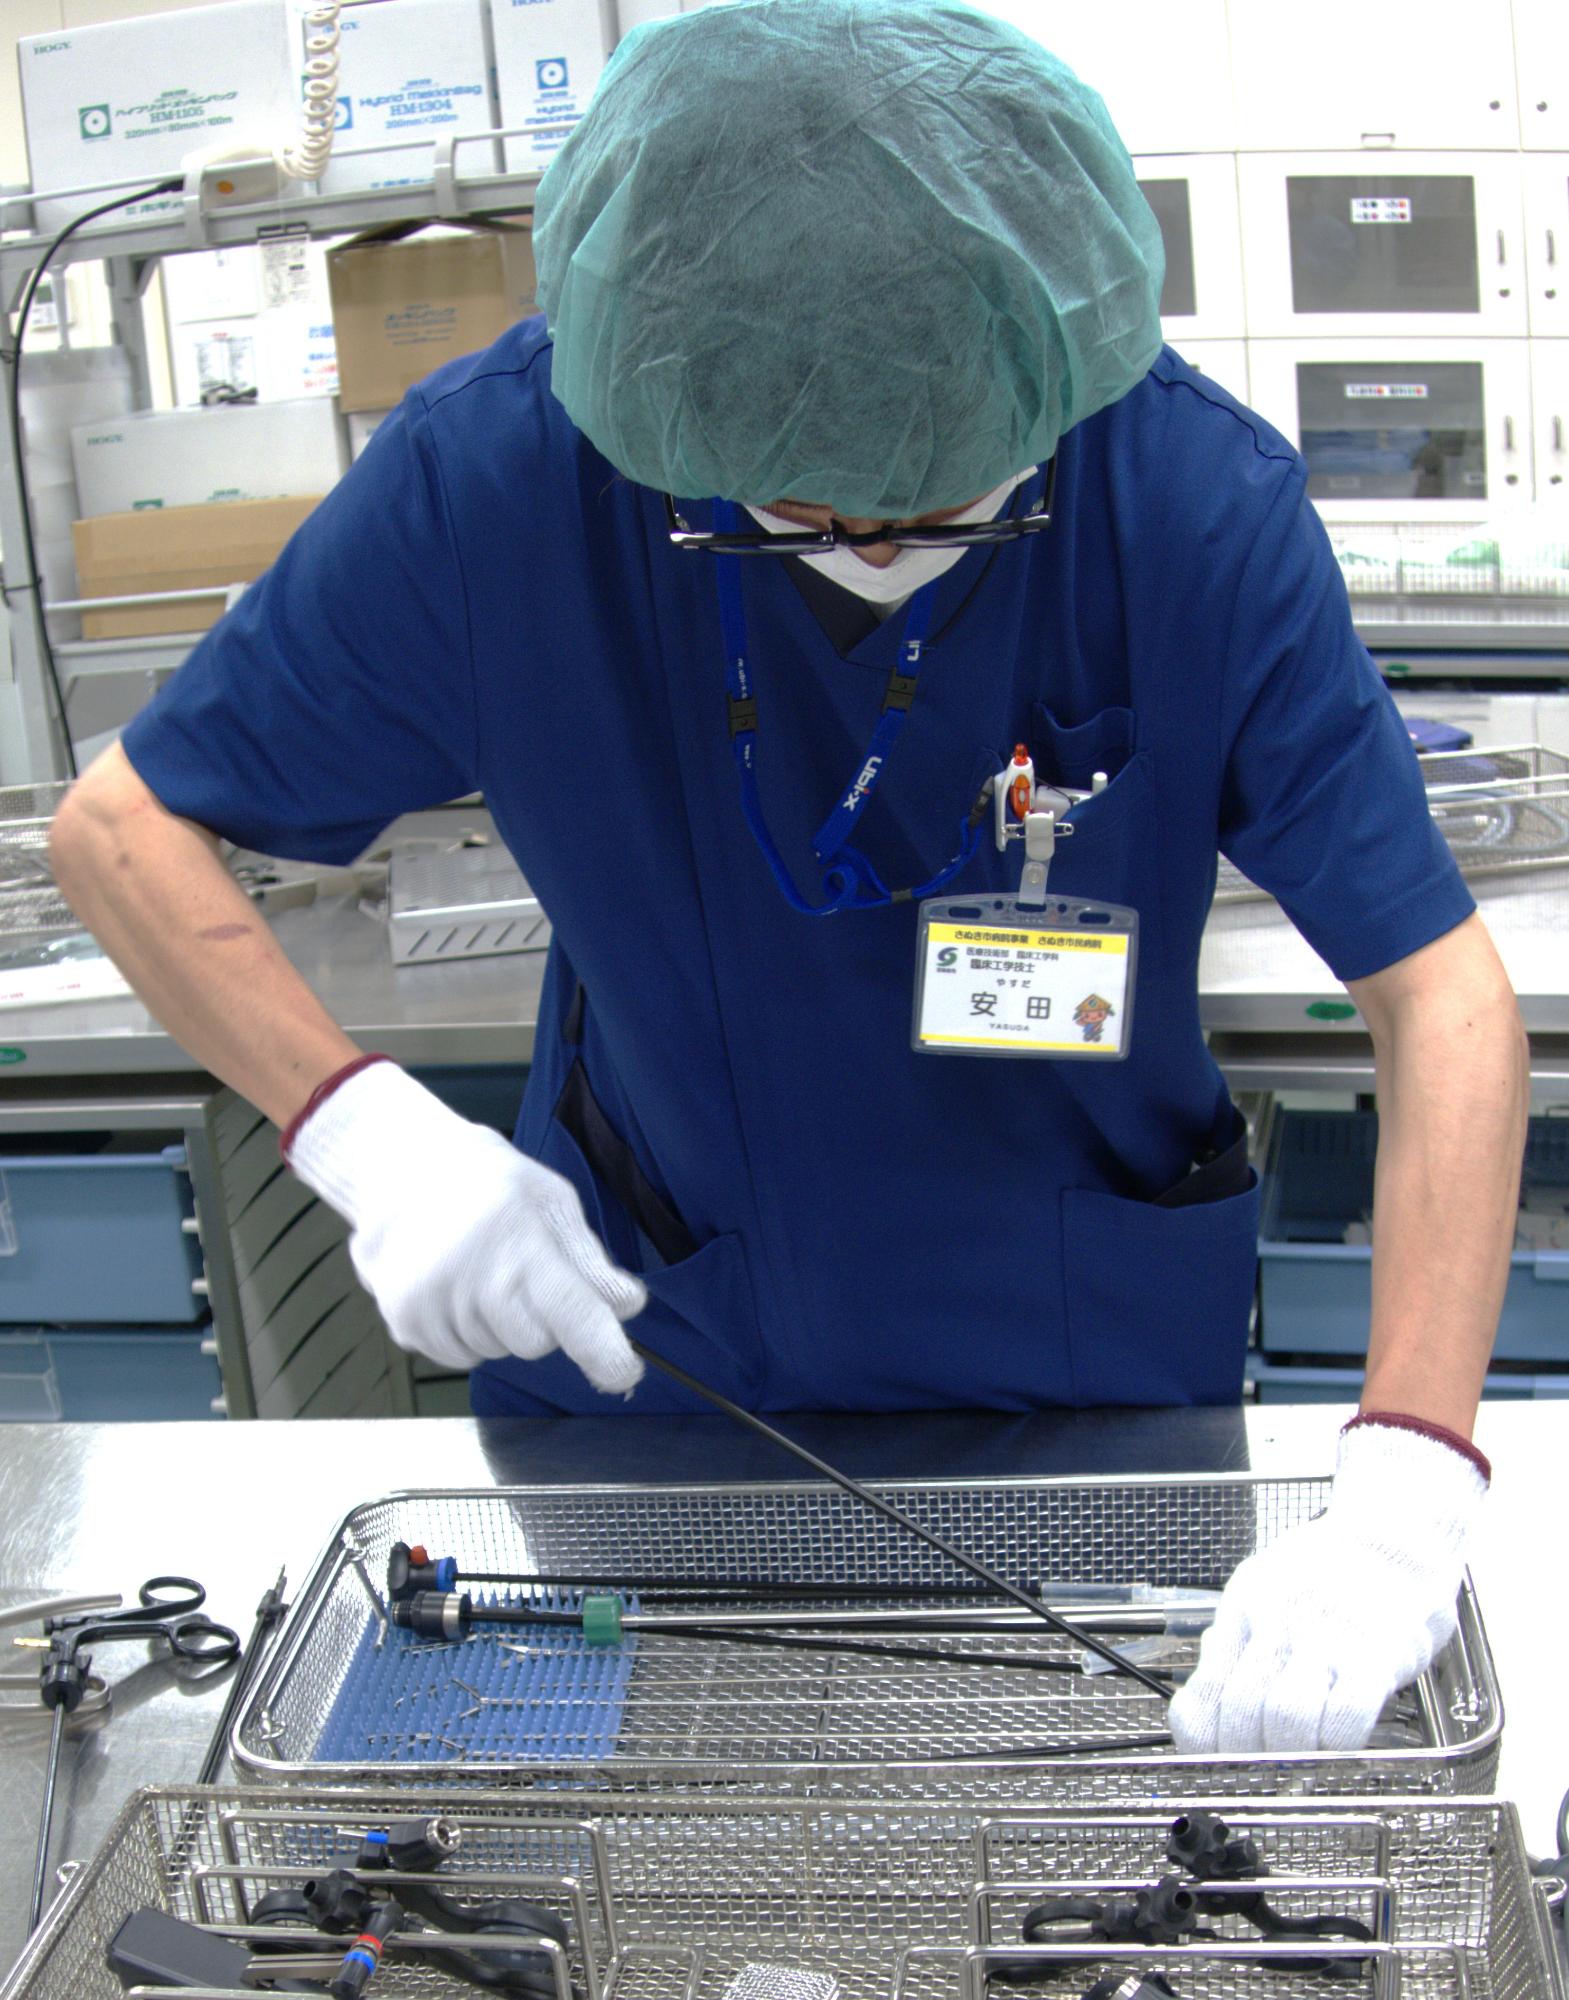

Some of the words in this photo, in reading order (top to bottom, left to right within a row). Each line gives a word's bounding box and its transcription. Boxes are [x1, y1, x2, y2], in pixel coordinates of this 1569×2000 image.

[954, 930, 1029, 945] さぬき市病院事業
[1038, 935, 1102, 949] さぬき市民病院
[970, 959, 1035, 973] 臨床工学技士
[989, 1023, 1030, 1032] YASUDA
